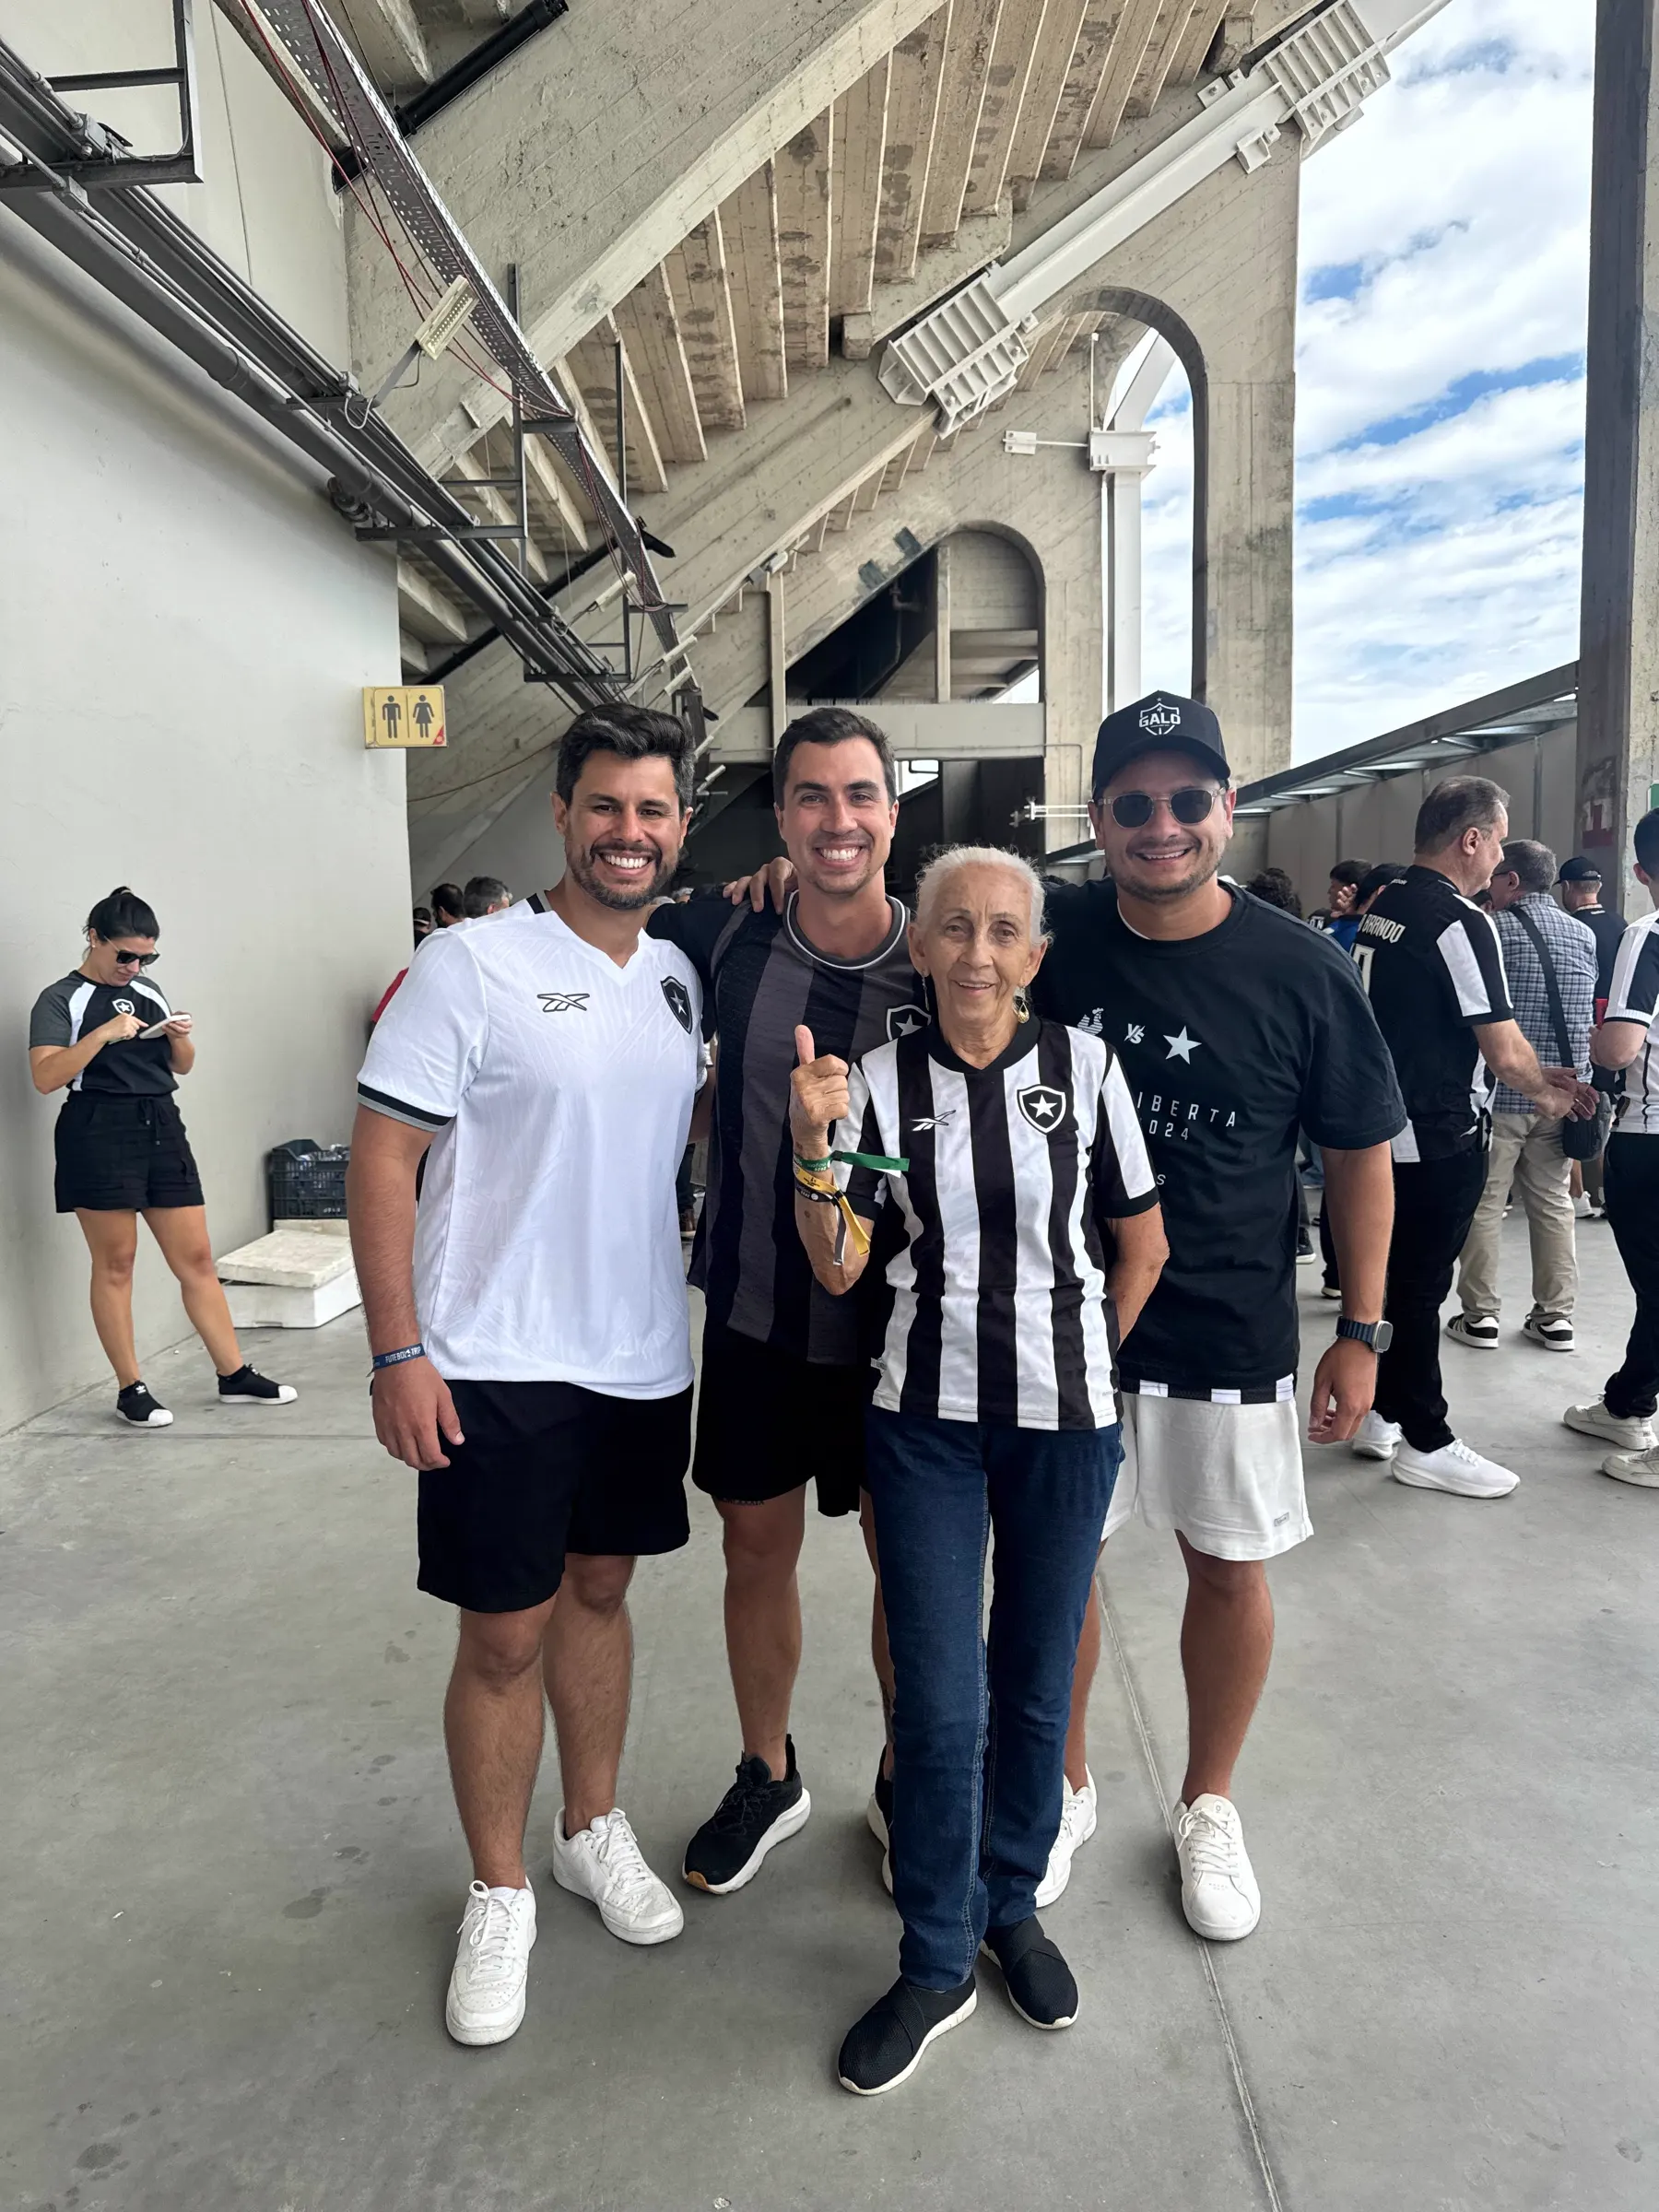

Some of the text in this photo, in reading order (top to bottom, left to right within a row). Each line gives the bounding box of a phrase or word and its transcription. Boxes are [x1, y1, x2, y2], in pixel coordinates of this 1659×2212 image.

[1139, 712, 1181, 727] GALO
[1124, 1023, 1146, 1044] VS
[1136, 1091, 1236, 1127] IBERTA
[1140, 1117, 1189, 1141] 024
